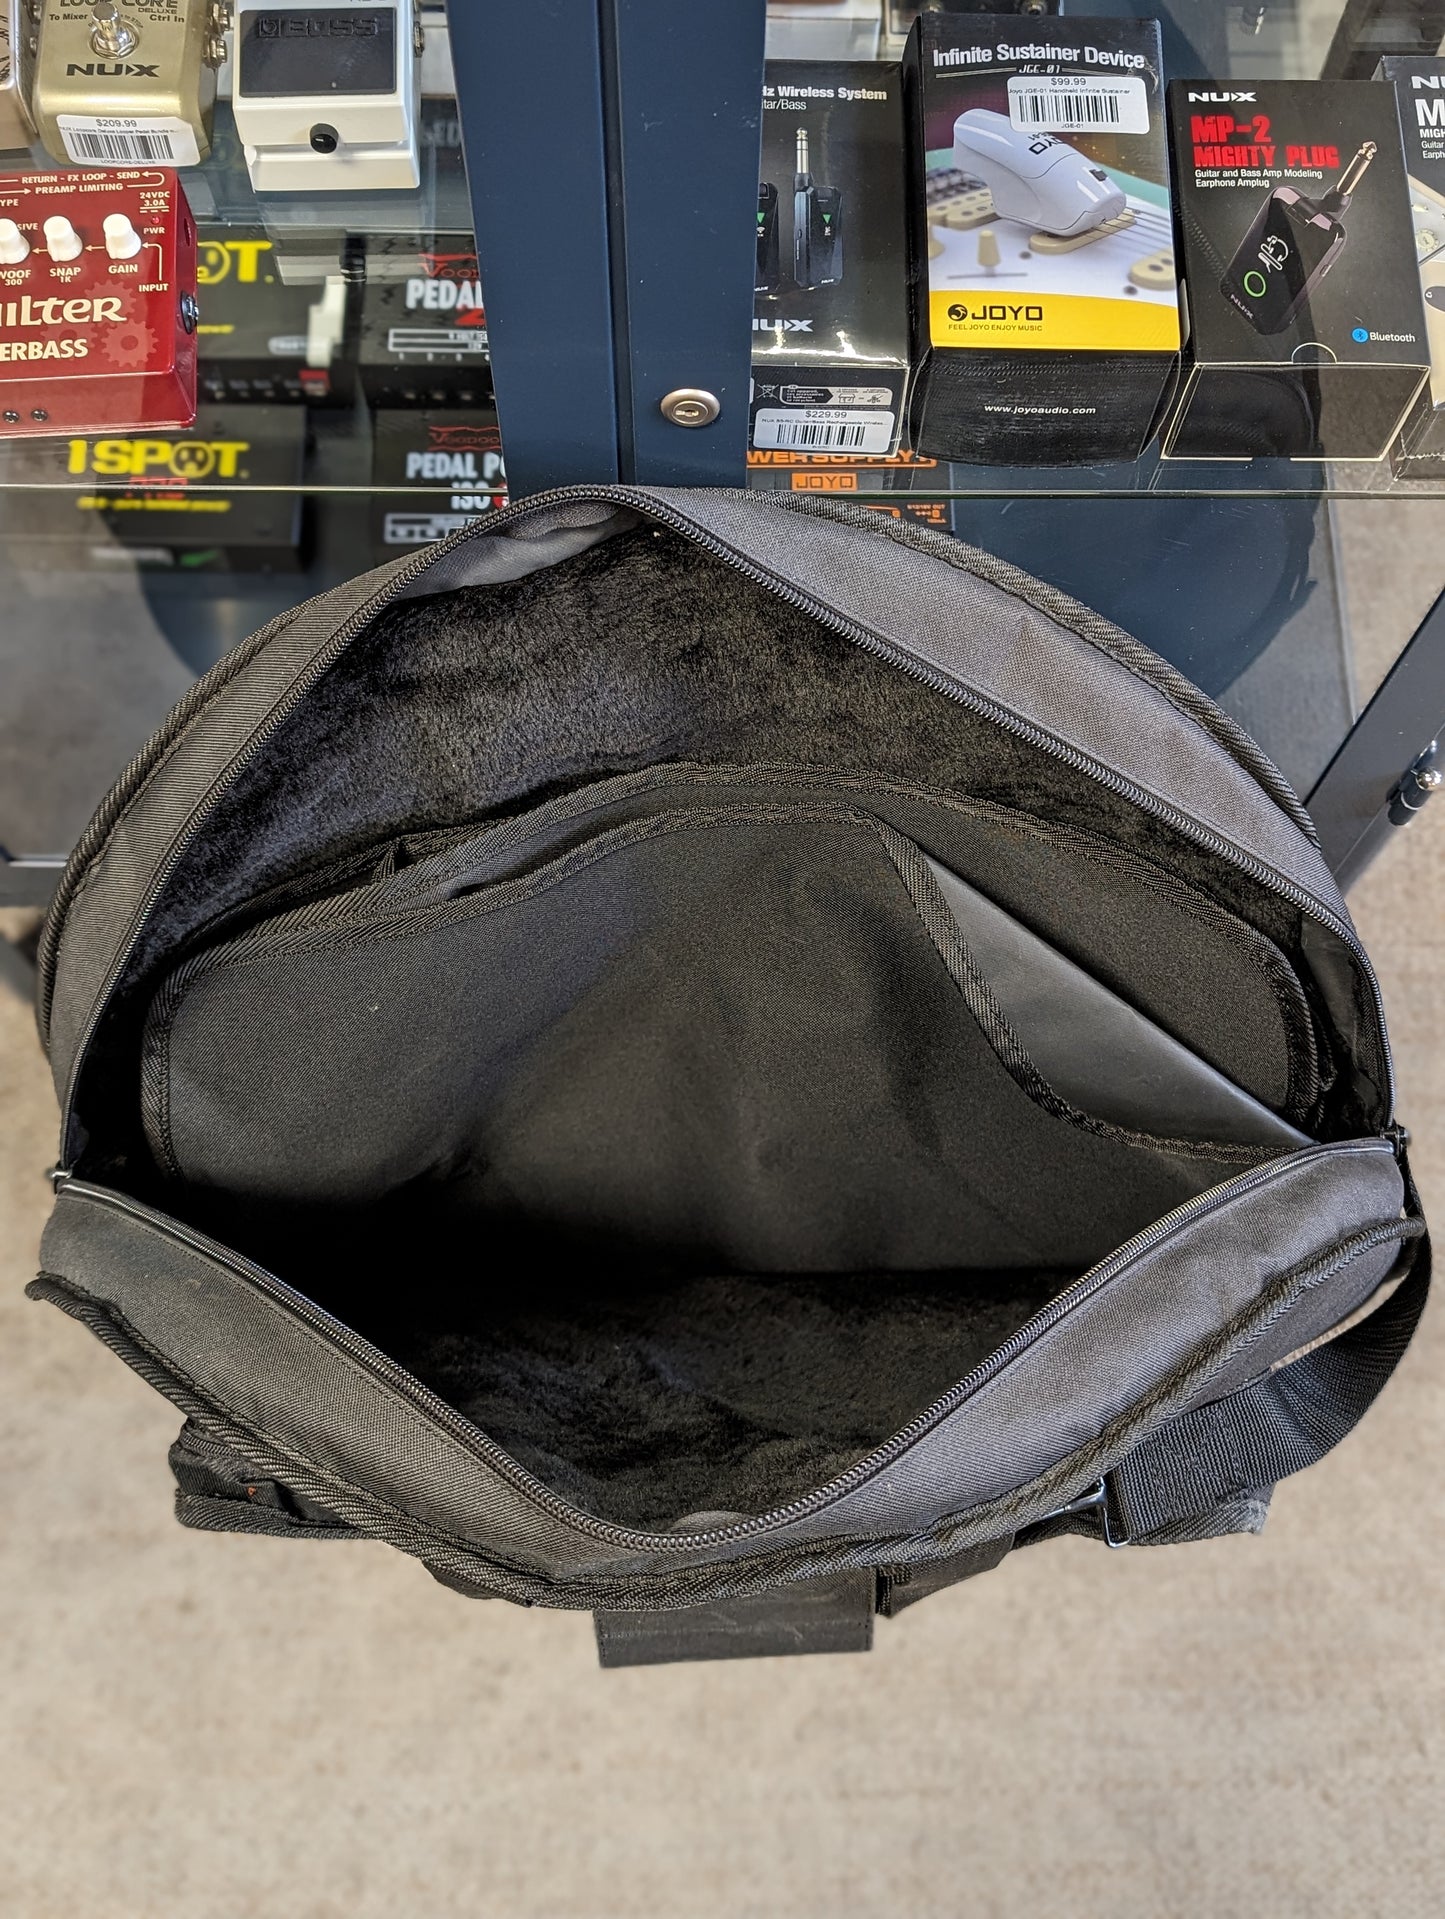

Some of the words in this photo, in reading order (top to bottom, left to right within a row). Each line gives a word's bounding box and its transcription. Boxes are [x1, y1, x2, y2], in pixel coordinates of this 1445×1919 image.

[285, 18, 378, 37] BOSS
[932, 46, 993, 67] Infinite
[996, 43, 1081, 62] Sustainer
[1084, 47, 1145, 69] Device
[66, 63, 160, 78] NUX
[1018, 64, 1061, 74] JGE-01
[1050, 77, 1087, 86] $99.99
[1411, 75, 1445, 89] N
[777, 85, 834, 98] Wireless
[838, 87, 888, 101] System
[1188, 92, 1257, 102] NUX
[96, 118, 137, 127] $209.99
[1190, 114, 1272, 143] MP-2
[1421, 141, 1445, 149] Guitar
[1193, 145, 1275, 168] MIGHTY
[1285, 146, 1340, 168] PLUG
[21, 175, 58, 184] RETURN
[67, 174, 79, 182] FX
[82, 173, 107, 181] LOOP
[117, 171, 140, 179] SEND
[1195, 169, 1221, 178] Guitar
[1223, 169, 1238, 178] and
[1240, 169, 1261, 178] Bass
[1263, 169, 1282, 179] Amp
[1284, 169, 1322, 179] Modeling
[35, 185, 76, 194] PREAMP
[79, 183, 124, 193] LIMITING
[1195, 179, 1236, 189] Earphone
[1237, 179, 1270, 189] Amplug
[139, 191, 171, 199] 24VDC
[143, 227, 165, 235] PWR
[49, 267, 81, 277] SNAP
[108, 264, 138, 274] GAIN
[4, 278, 22, 286] 300
[138, 284, 169, 293] INPUT
[971, 305, 1043, 321] JOYO
[1369, 331, 1416, 343] Bluetooth
[805, 410, 847, 419] $229.99
[984, 404, 1096, 415] www.joyoaudio.com
[406, 452, 478, 479] PEDAL
[796, 476, 853, 488] JOYO
[451, 481, 490, 510] ISO
